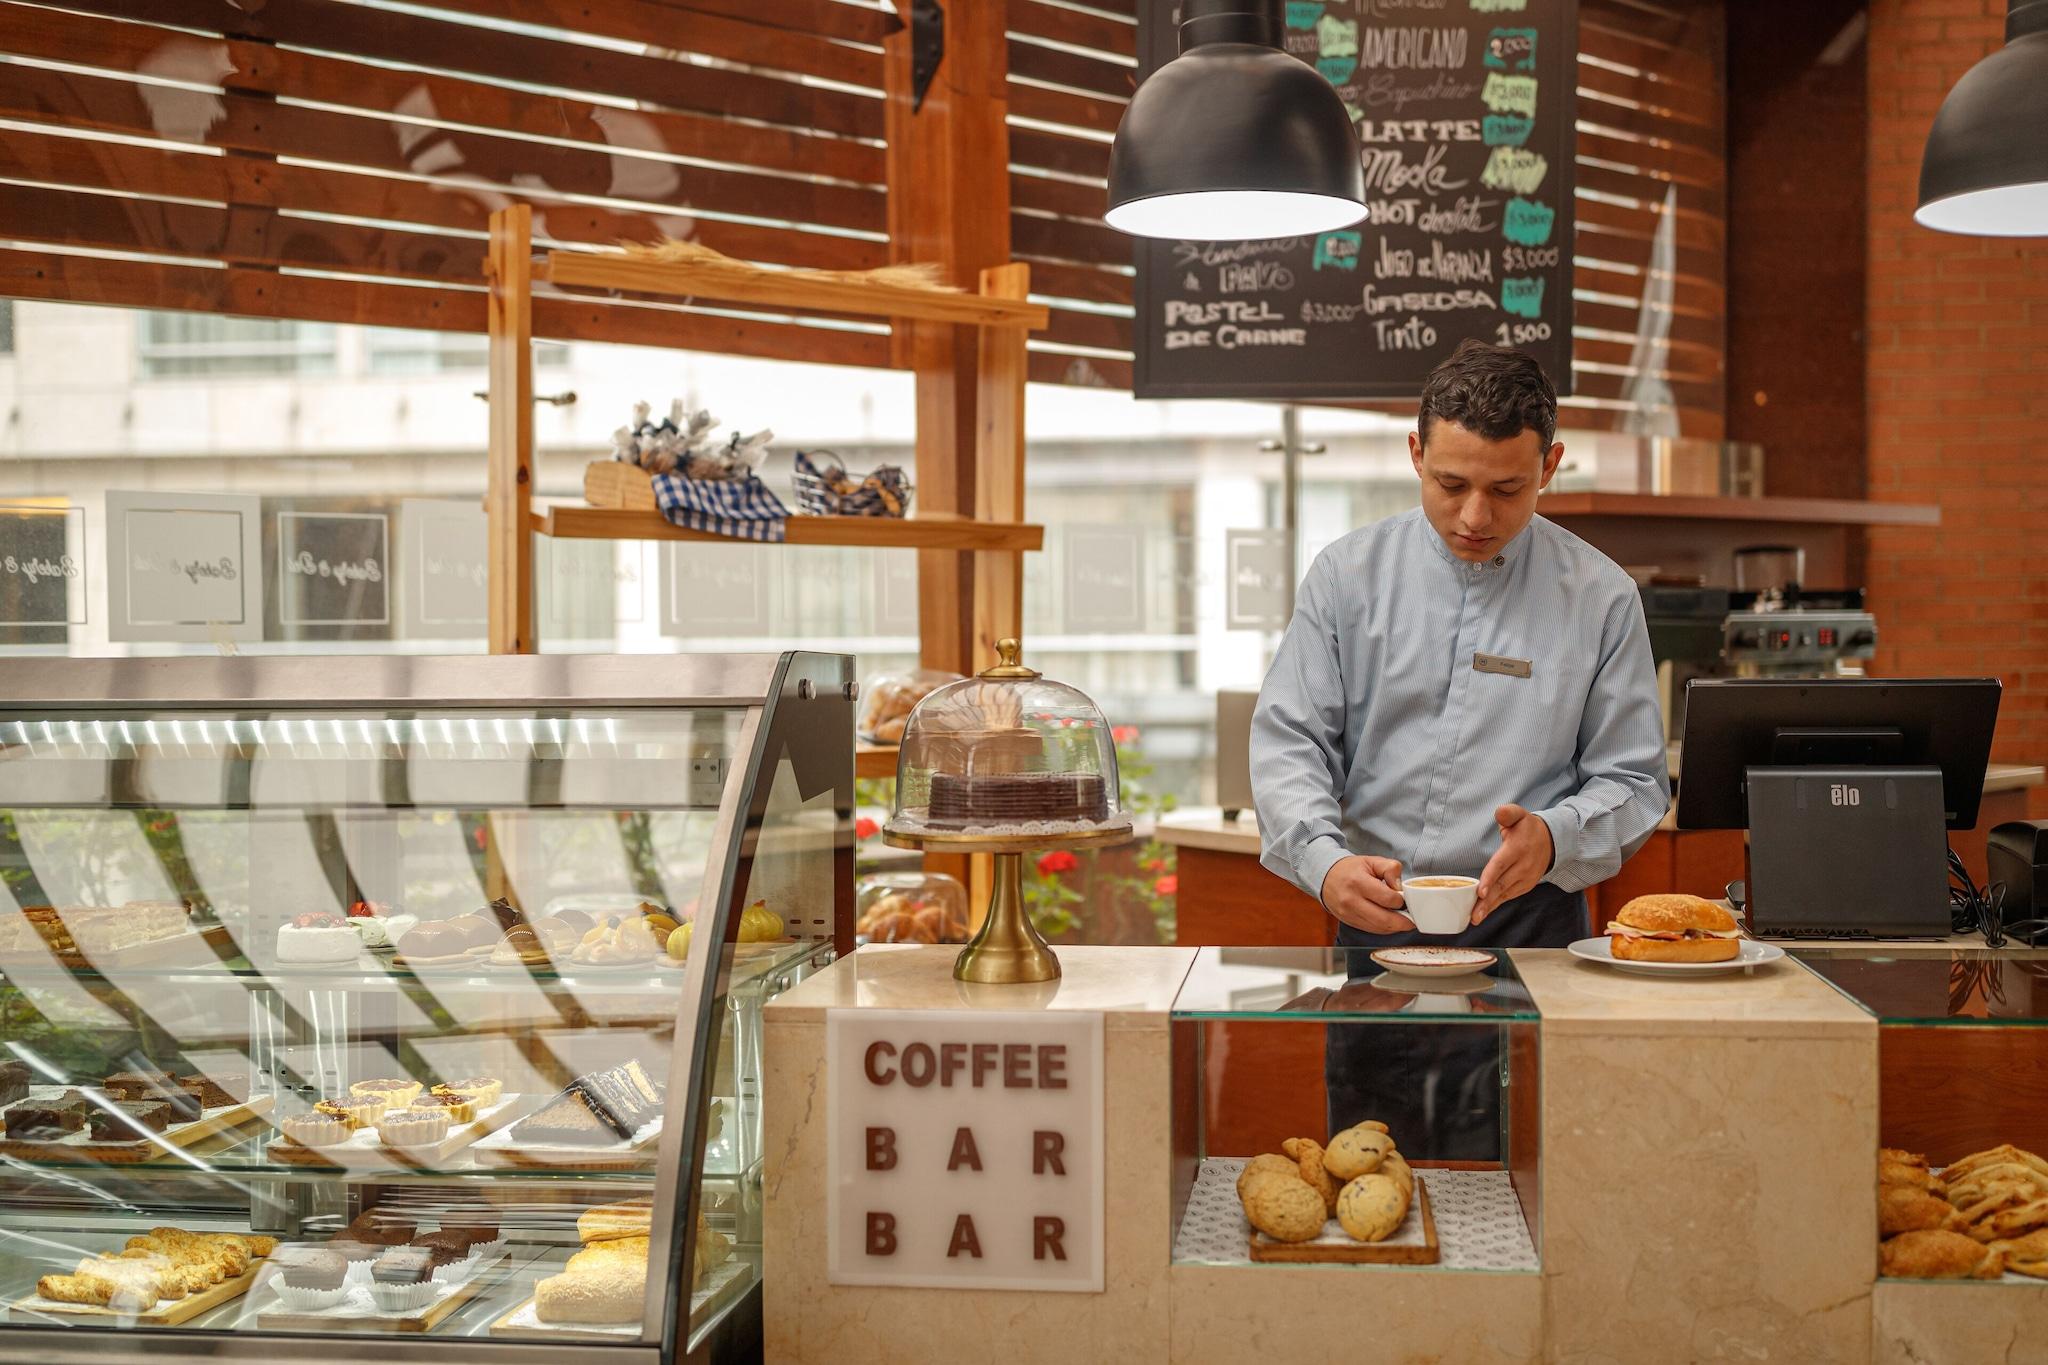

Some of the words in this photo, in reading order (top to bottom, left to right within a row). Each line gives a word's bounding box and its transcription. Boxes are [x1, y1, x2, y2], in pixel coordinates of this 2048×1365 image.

[1361, 26, 1468, 69] AMERICANO
[1361, 119, 1481, 143] LATTE
[1369, 198, 1421, 226] HOT
[1372, 315, 1437, 351] Tinto
[864, 1041, 1068, 1089] COFFEE
